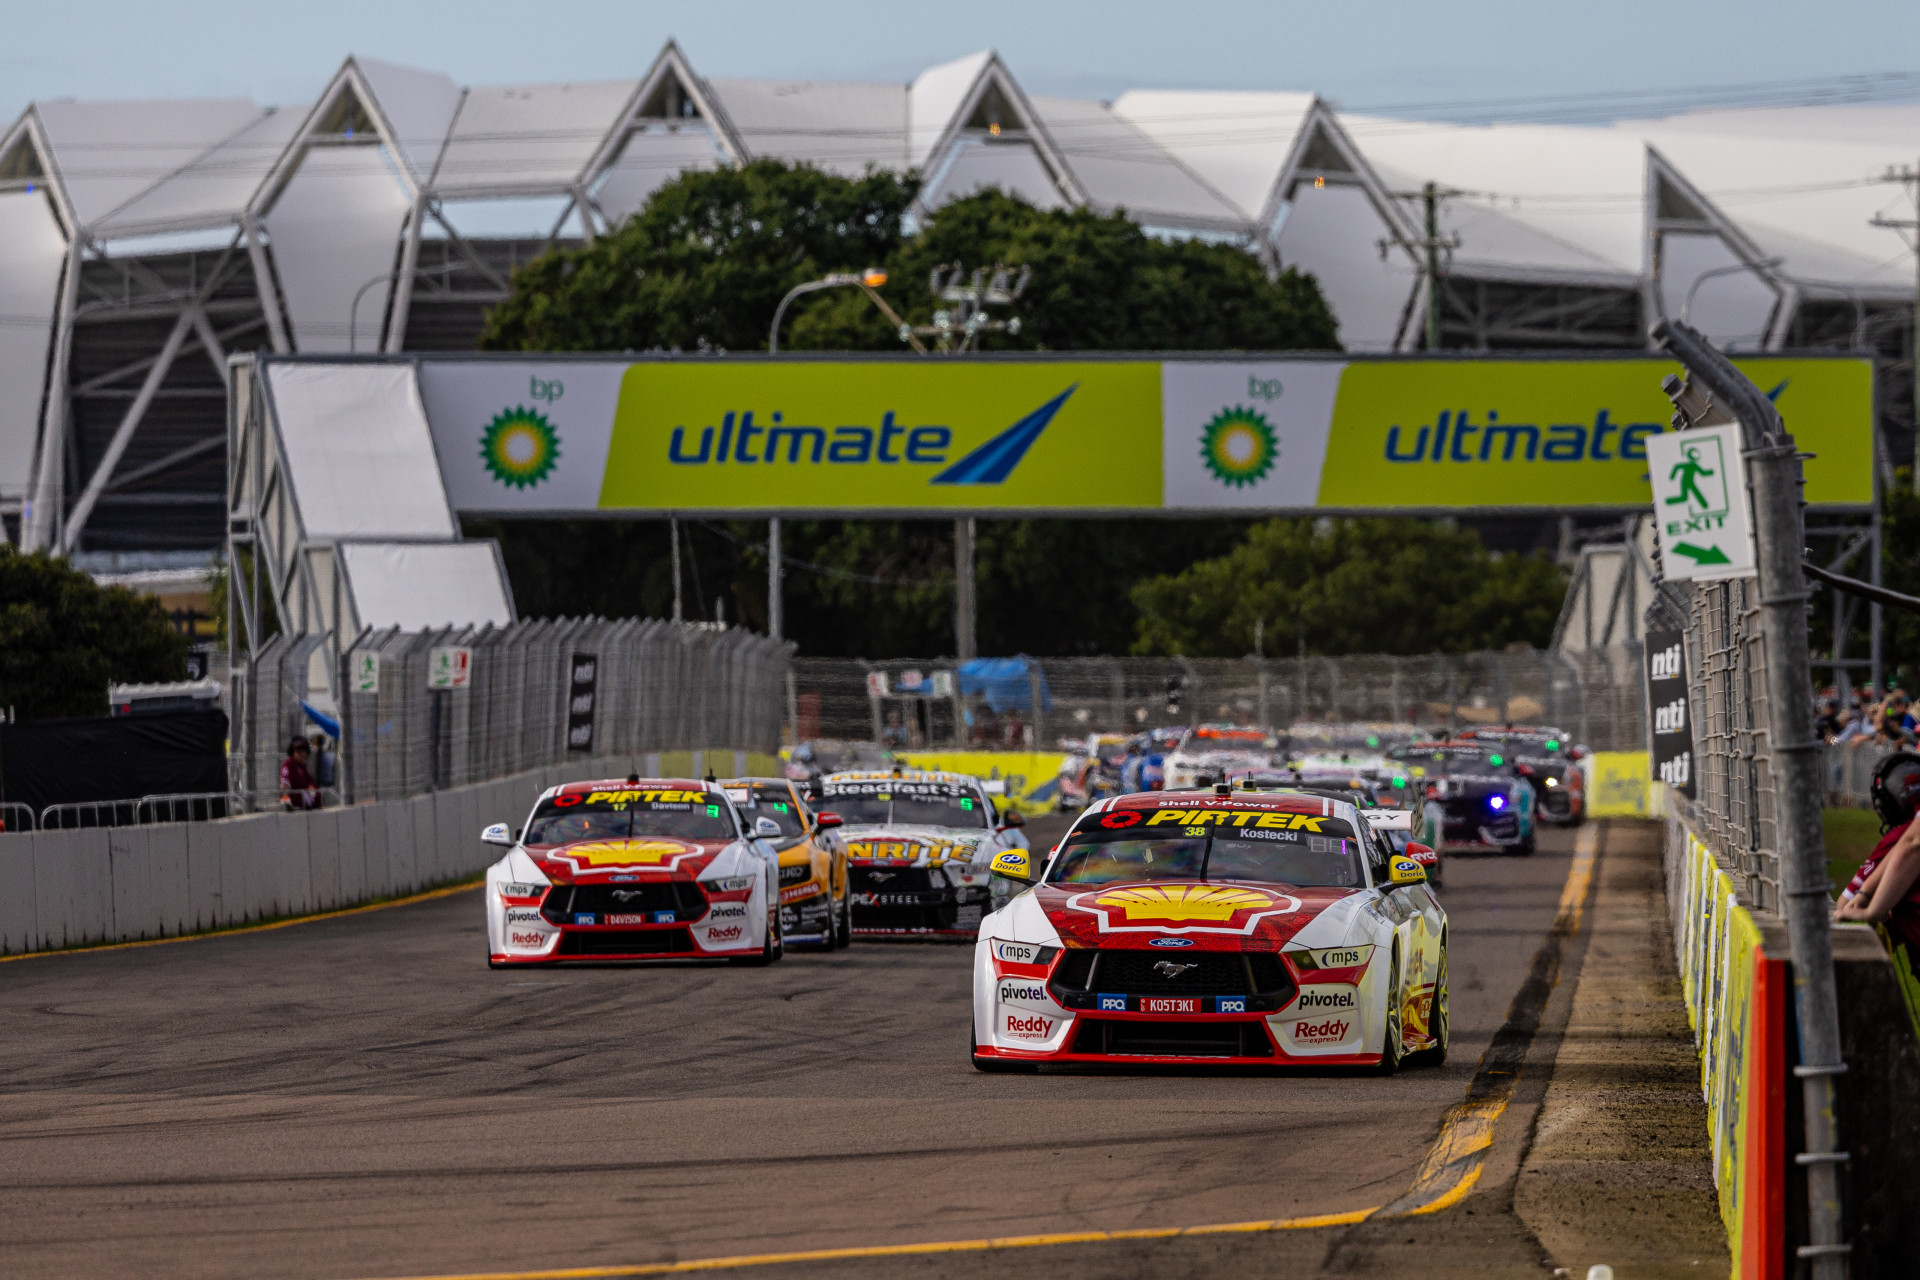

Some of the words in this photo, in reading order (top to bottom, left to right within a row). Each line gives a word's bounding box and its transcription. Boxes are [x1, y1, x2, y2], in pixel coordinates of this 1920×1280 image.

[530, 375, 564, 403] bp
[1248, 376, 1282, 402] bp
[667, 410, 953, 464] ultimate
[1384, 409, 1664, 464] ultimate
[1666, 515, 1723, 536] EXIT
[823, 782, 940, 796] Steadfast
[585, 790, 708, 804] PIRTEK
[651, 802, 690, 811] Davison
[1204, 801, 1279, 809] V-Power
[1146, 810, 1329, 832] PIRTEK
[1184, 827, 1206, 837] 38
[1240, 828, 1298, 841] Kostecki
[848, 841, 977, 863] NRITE
[995, 862, 1021, 872] Doric
[1400, 870, 1423, 878] Doric
[510, 886, 528, 894] mps
[881, 895, 920, 904] STEEL
[512, 932, 546, 946] Reddy
[707, 925, 742, 939] Reddy
[1157, 938, 1186, 946] Ford
[1006, 946, 1031, 960] mps
[1331, 950, 1359, 965] mps
[1102, 999, 1125, 1010] PPQ
[1221, 1001, 1245, 1012] PPQ
[1007, 1016, 1053, 1038] Reddy
[1294, 1019, 1350, 1041] Reddy
[1309, 1036, 1338, 1044] express
